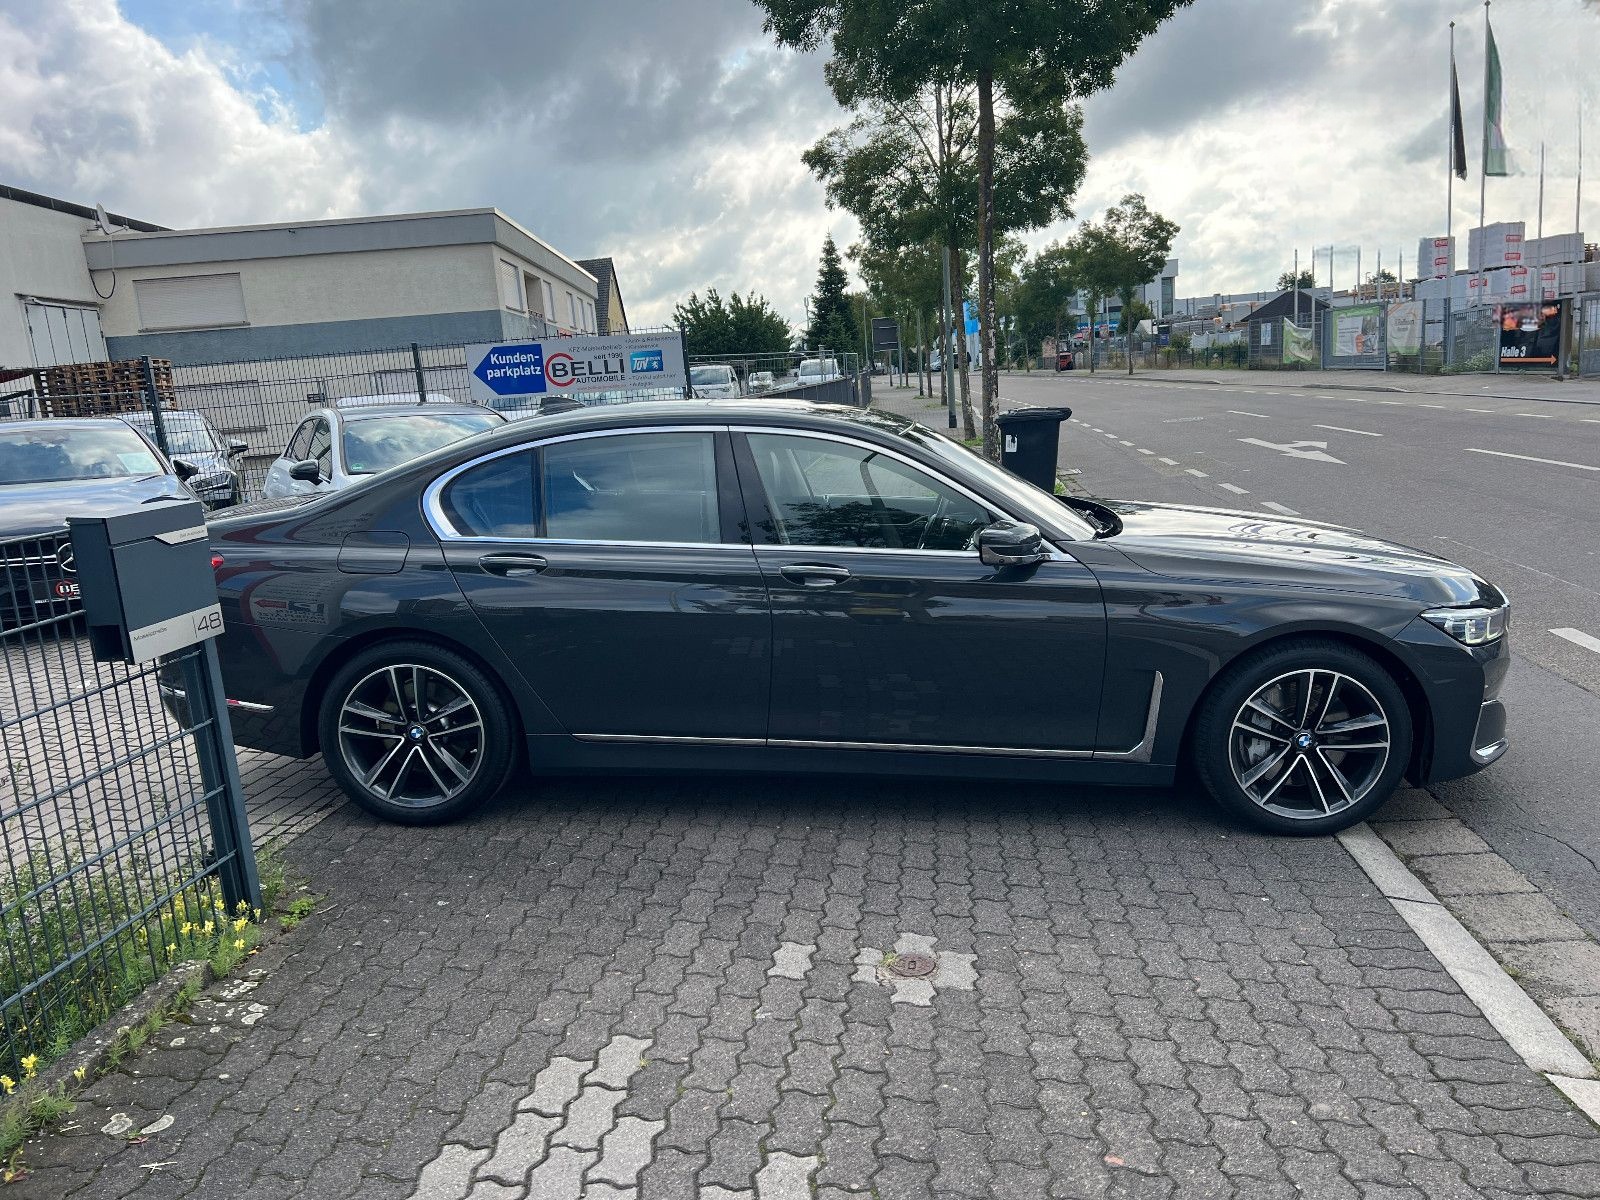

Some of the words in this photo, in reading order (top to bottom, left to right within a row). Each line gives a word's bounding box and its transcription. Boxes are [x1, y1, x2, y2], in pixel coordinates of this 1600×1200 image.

[1501, 346, 1520, 357] Halle
[1520, 345, 1527, 357] 3
[490, 353, 540, 366] Kunden-
[486, 364, 542, 381] parkplatz
[552, 358, 625, 379] BELLI
[576, 375, 626, 385] AUTOMOBILE
[197, 611, 222, 632] 48
